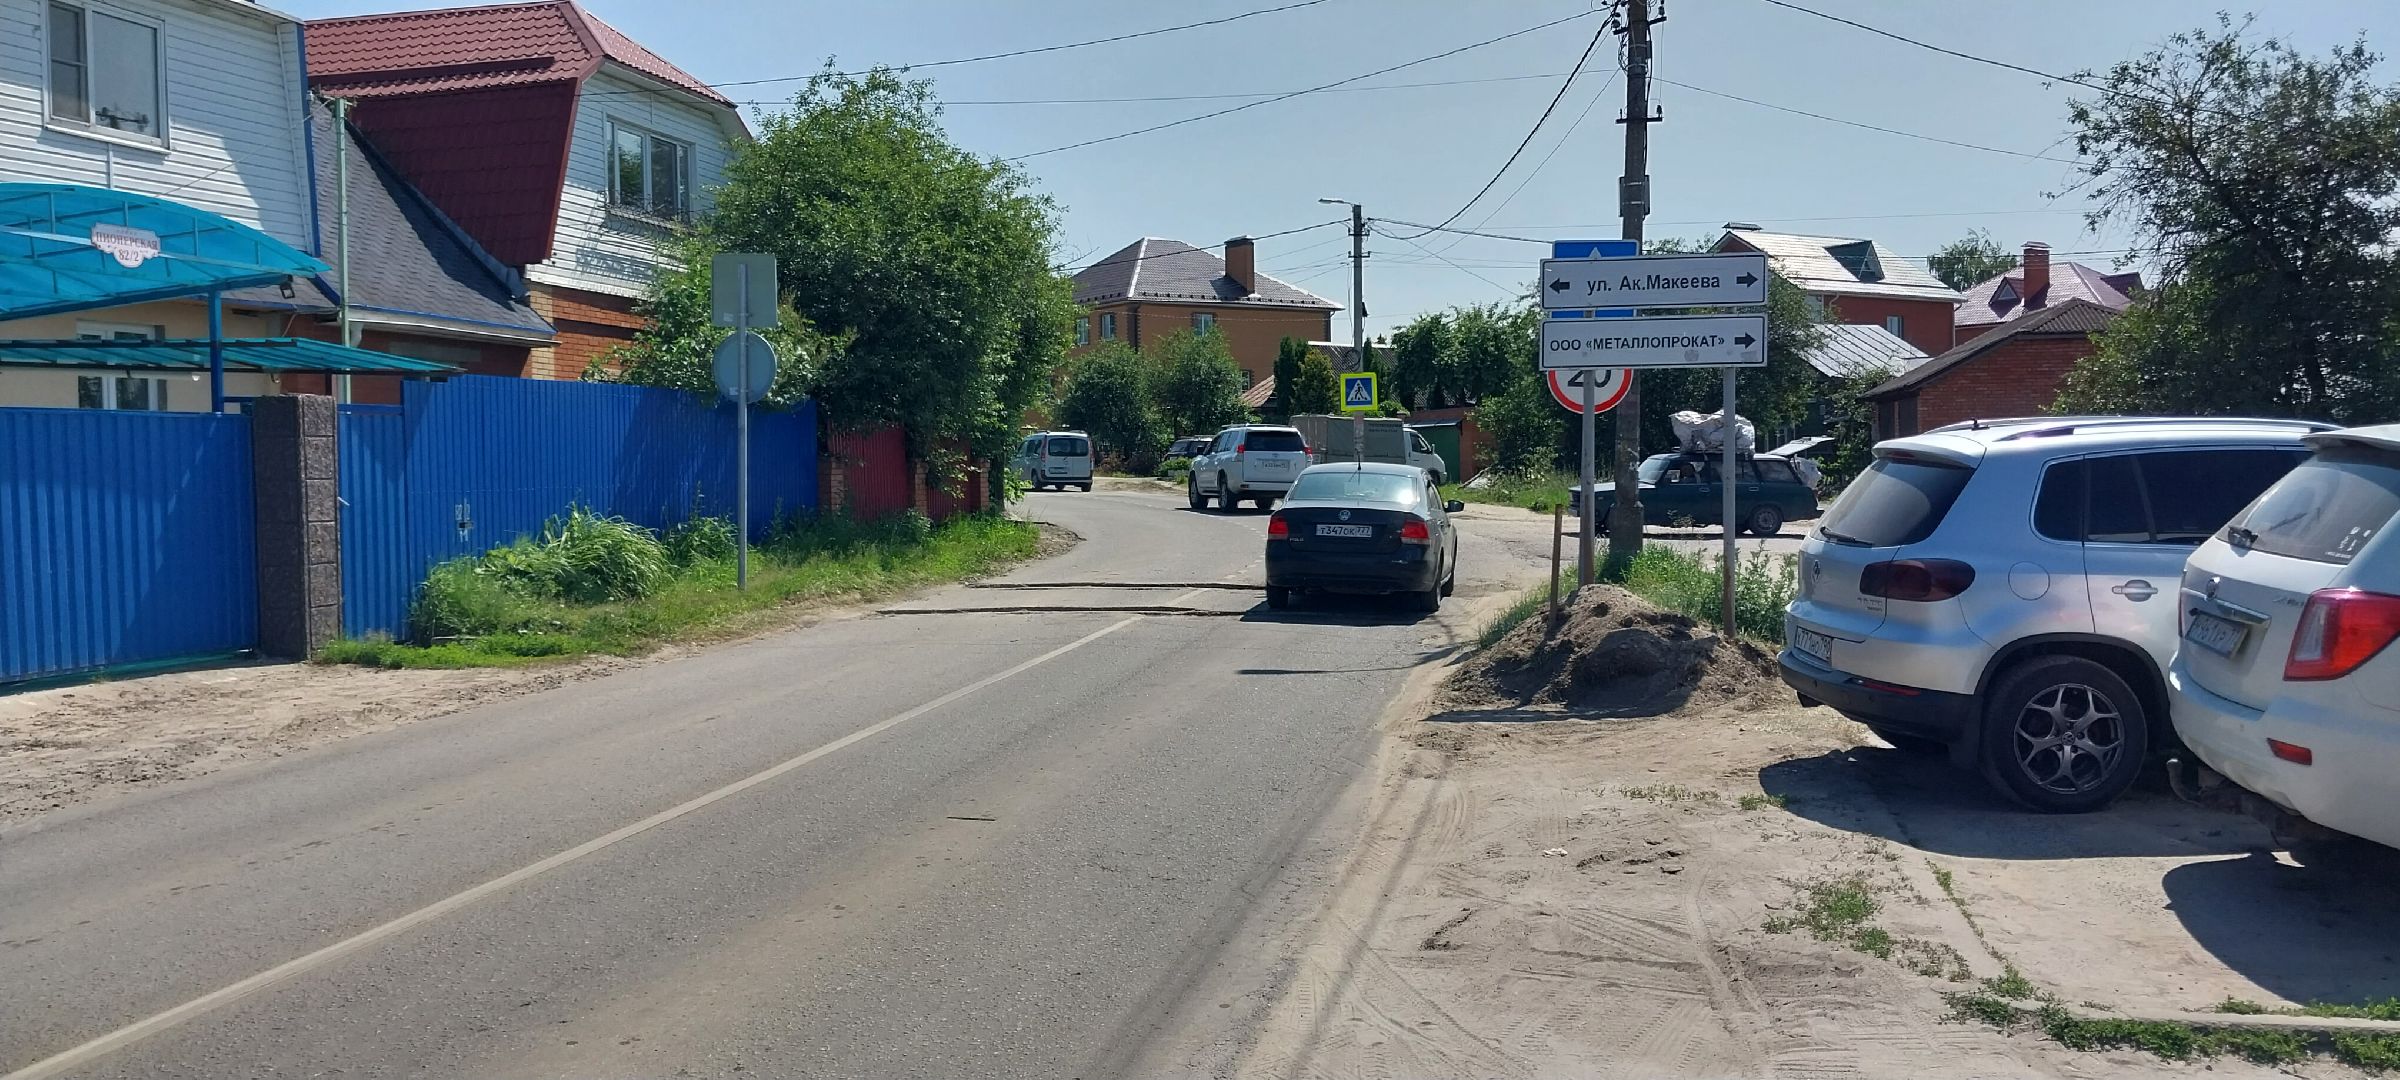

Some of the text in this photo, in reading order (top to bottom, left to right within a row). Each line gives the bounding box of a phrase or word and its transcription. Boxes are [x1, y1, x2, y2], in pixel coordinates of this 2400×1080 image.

[96, 231, 158, 250] ПИОНЕРСКАЯ
[118, 249, 139, 262] 82/2
[1587, 274, 1720, 296] ул. Ак.Макеева
[1550, 334, 1725, 351] ООО «МЕТАЛЛОПРОКАТ»
